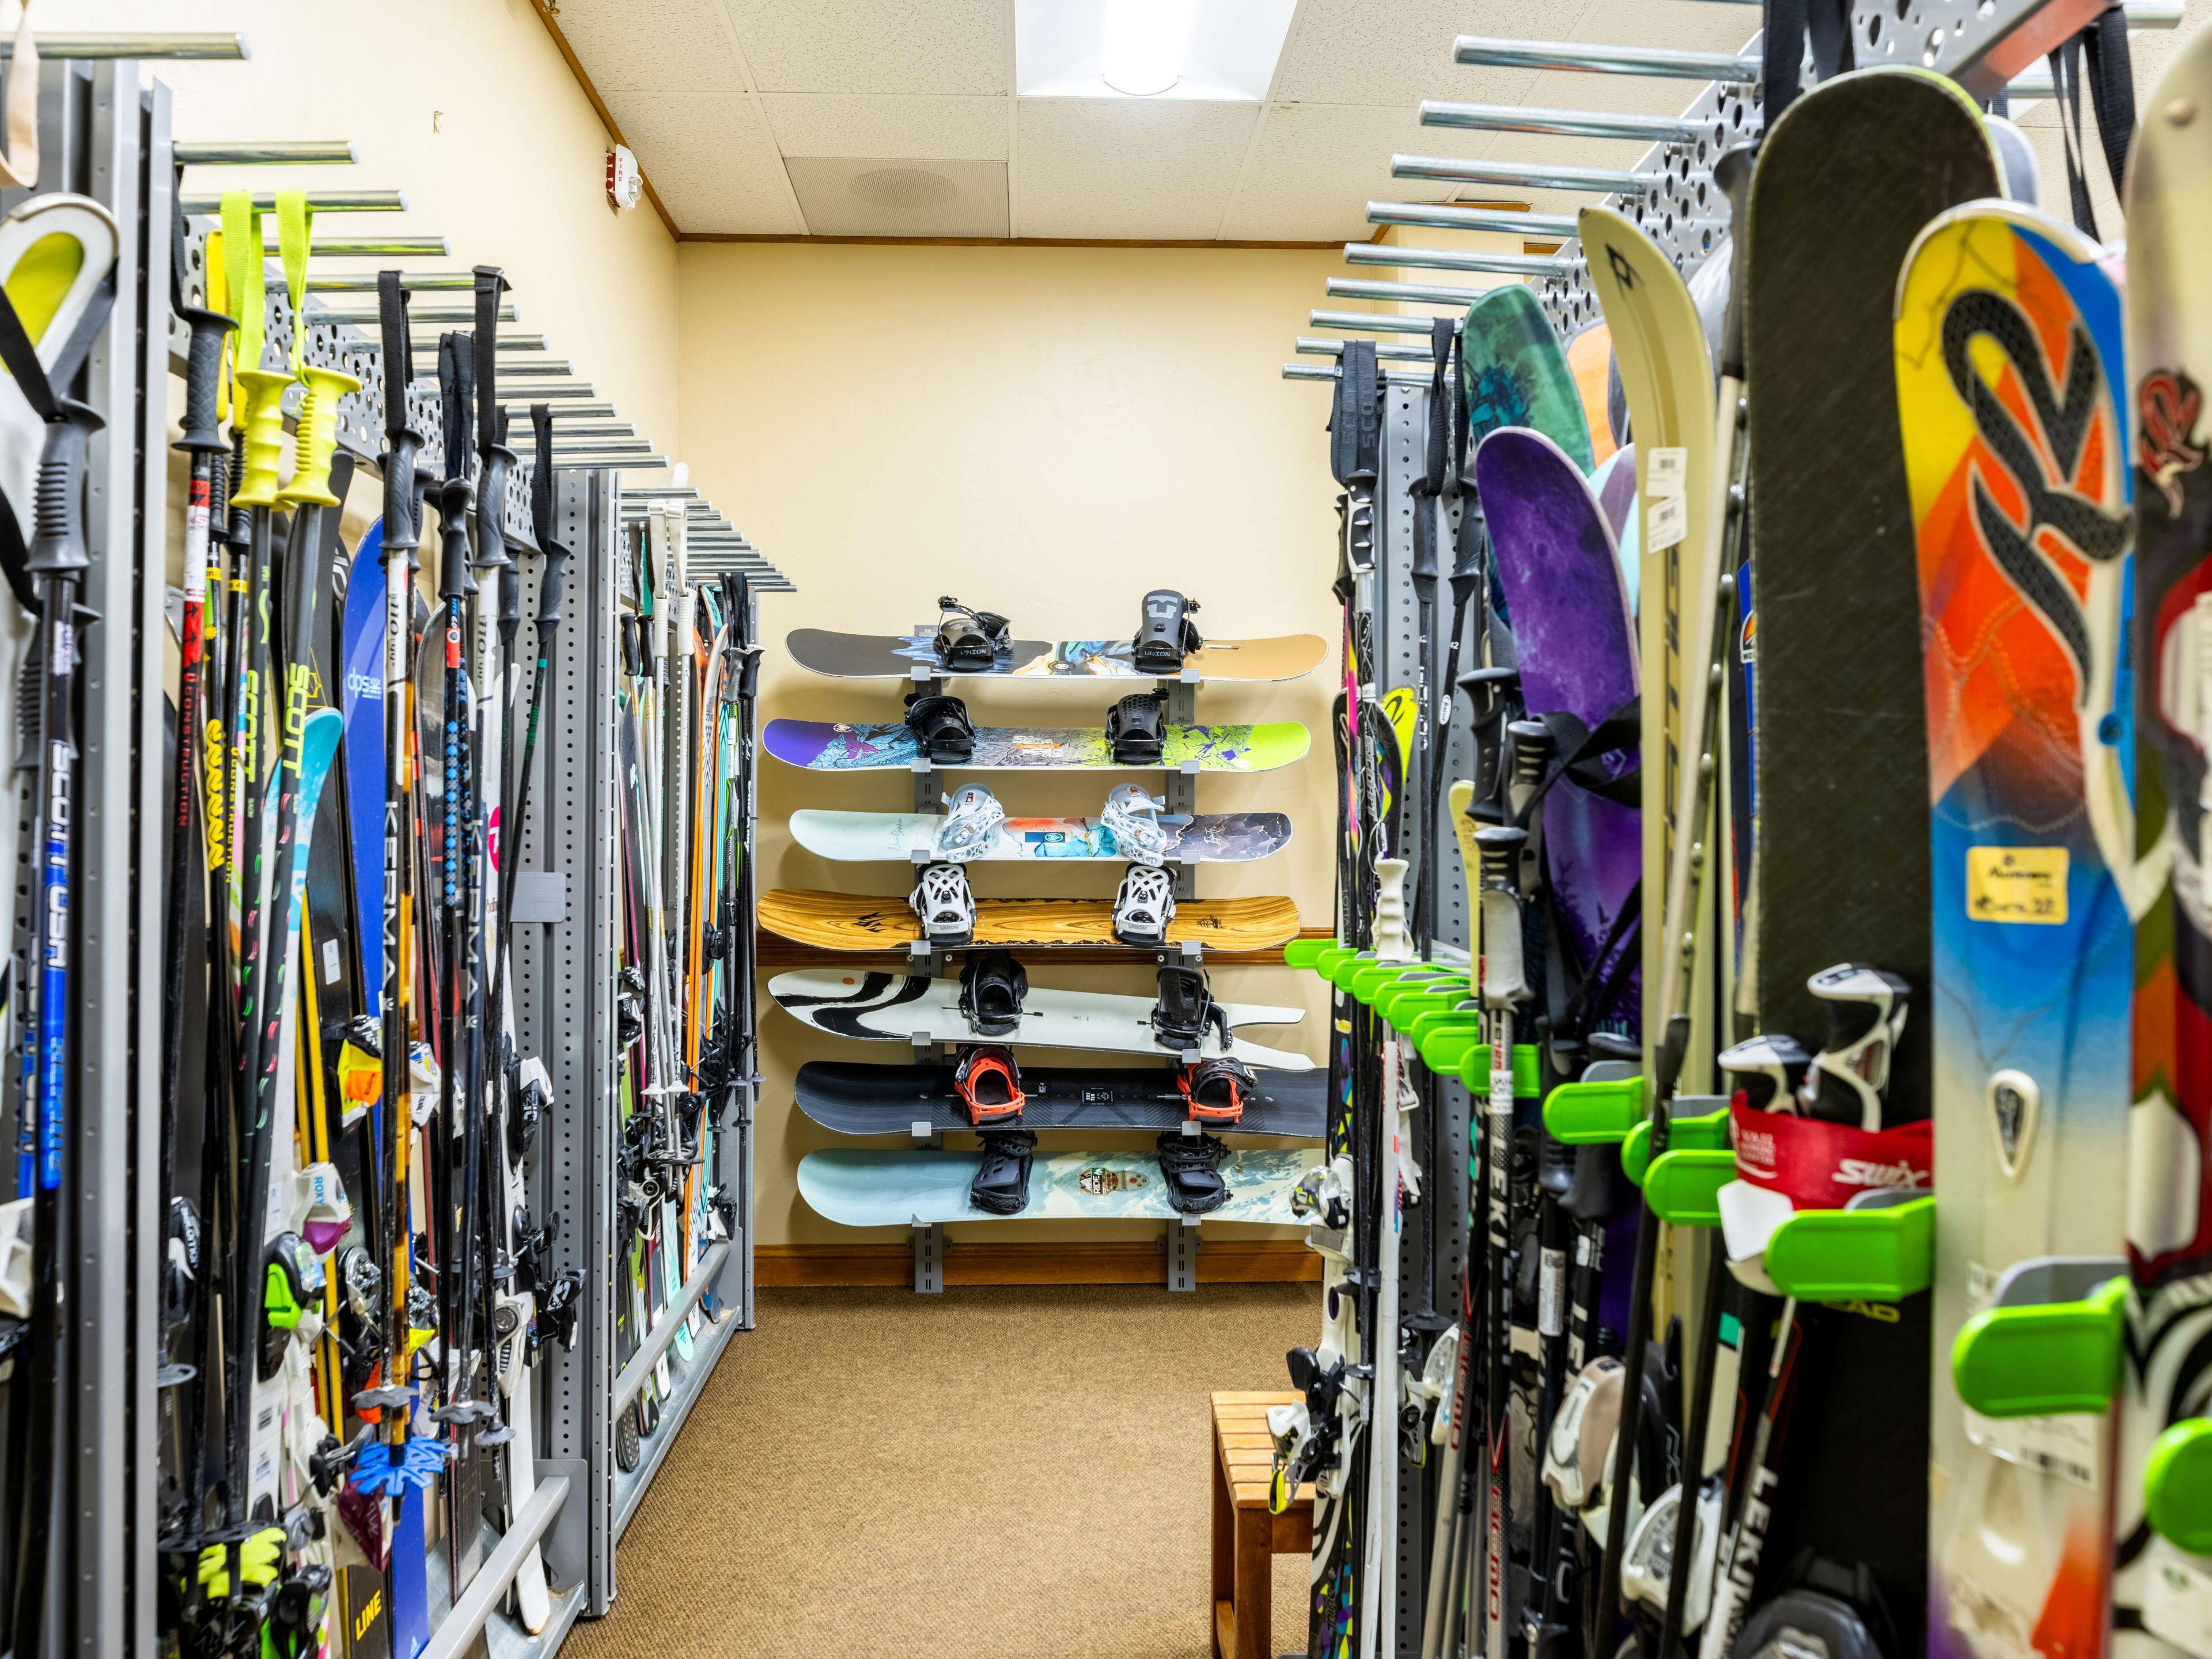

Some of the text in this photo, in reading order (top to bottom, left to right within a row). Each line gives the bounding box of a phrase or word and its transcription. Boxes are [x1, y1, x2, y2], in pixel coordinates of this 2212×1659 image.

[282, 663, 310, 779] SCOTT
[347, 666, 369, 698] dps
[1365, 736, 1378, 823] SCOTT
[48, 743, 70, 968] SCOTT USA
[382, 802, 399, 992] KERMA
[466, 819, 483, 998] KERMA
[314, 1176, 324, 1205] ROXY
[1092, 1175, 1100, 1195] RIDE
[1489, 1137, 1508, 1249] LEKI
[1730, 1464, 1779, 1588] LEKI
[355, 1588, 382, 1642] LINE
